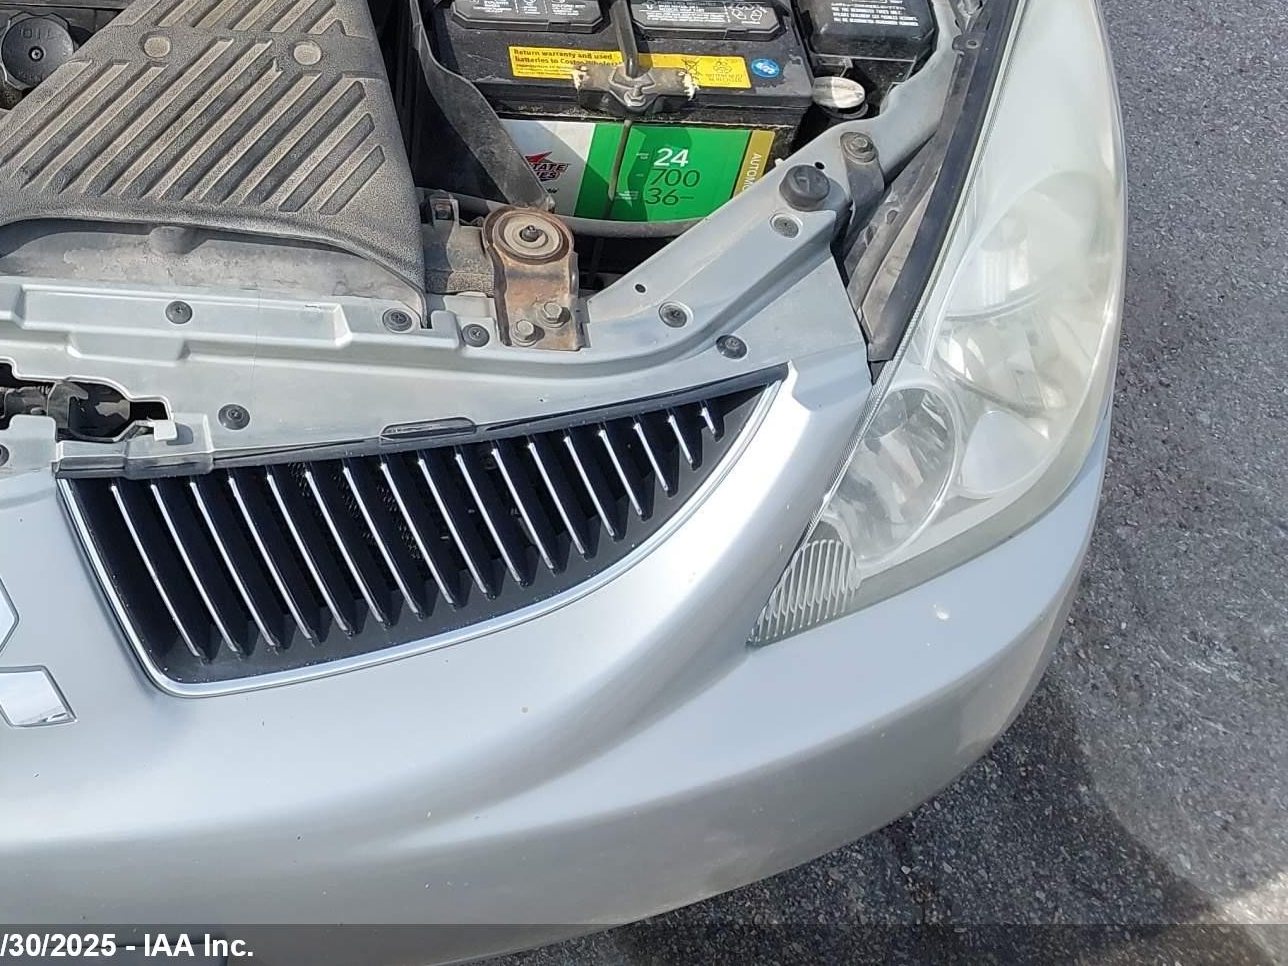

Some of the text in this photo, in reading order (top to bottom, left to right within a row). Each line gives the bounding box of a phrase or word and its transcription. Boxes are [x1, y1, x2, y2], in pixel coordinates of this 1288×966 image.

[513, 48, 540, 56] Return
[542, 51, 575, 59] warranty
[653, 147, 689, 167] 24
[650, 168, 701, 187] 700
